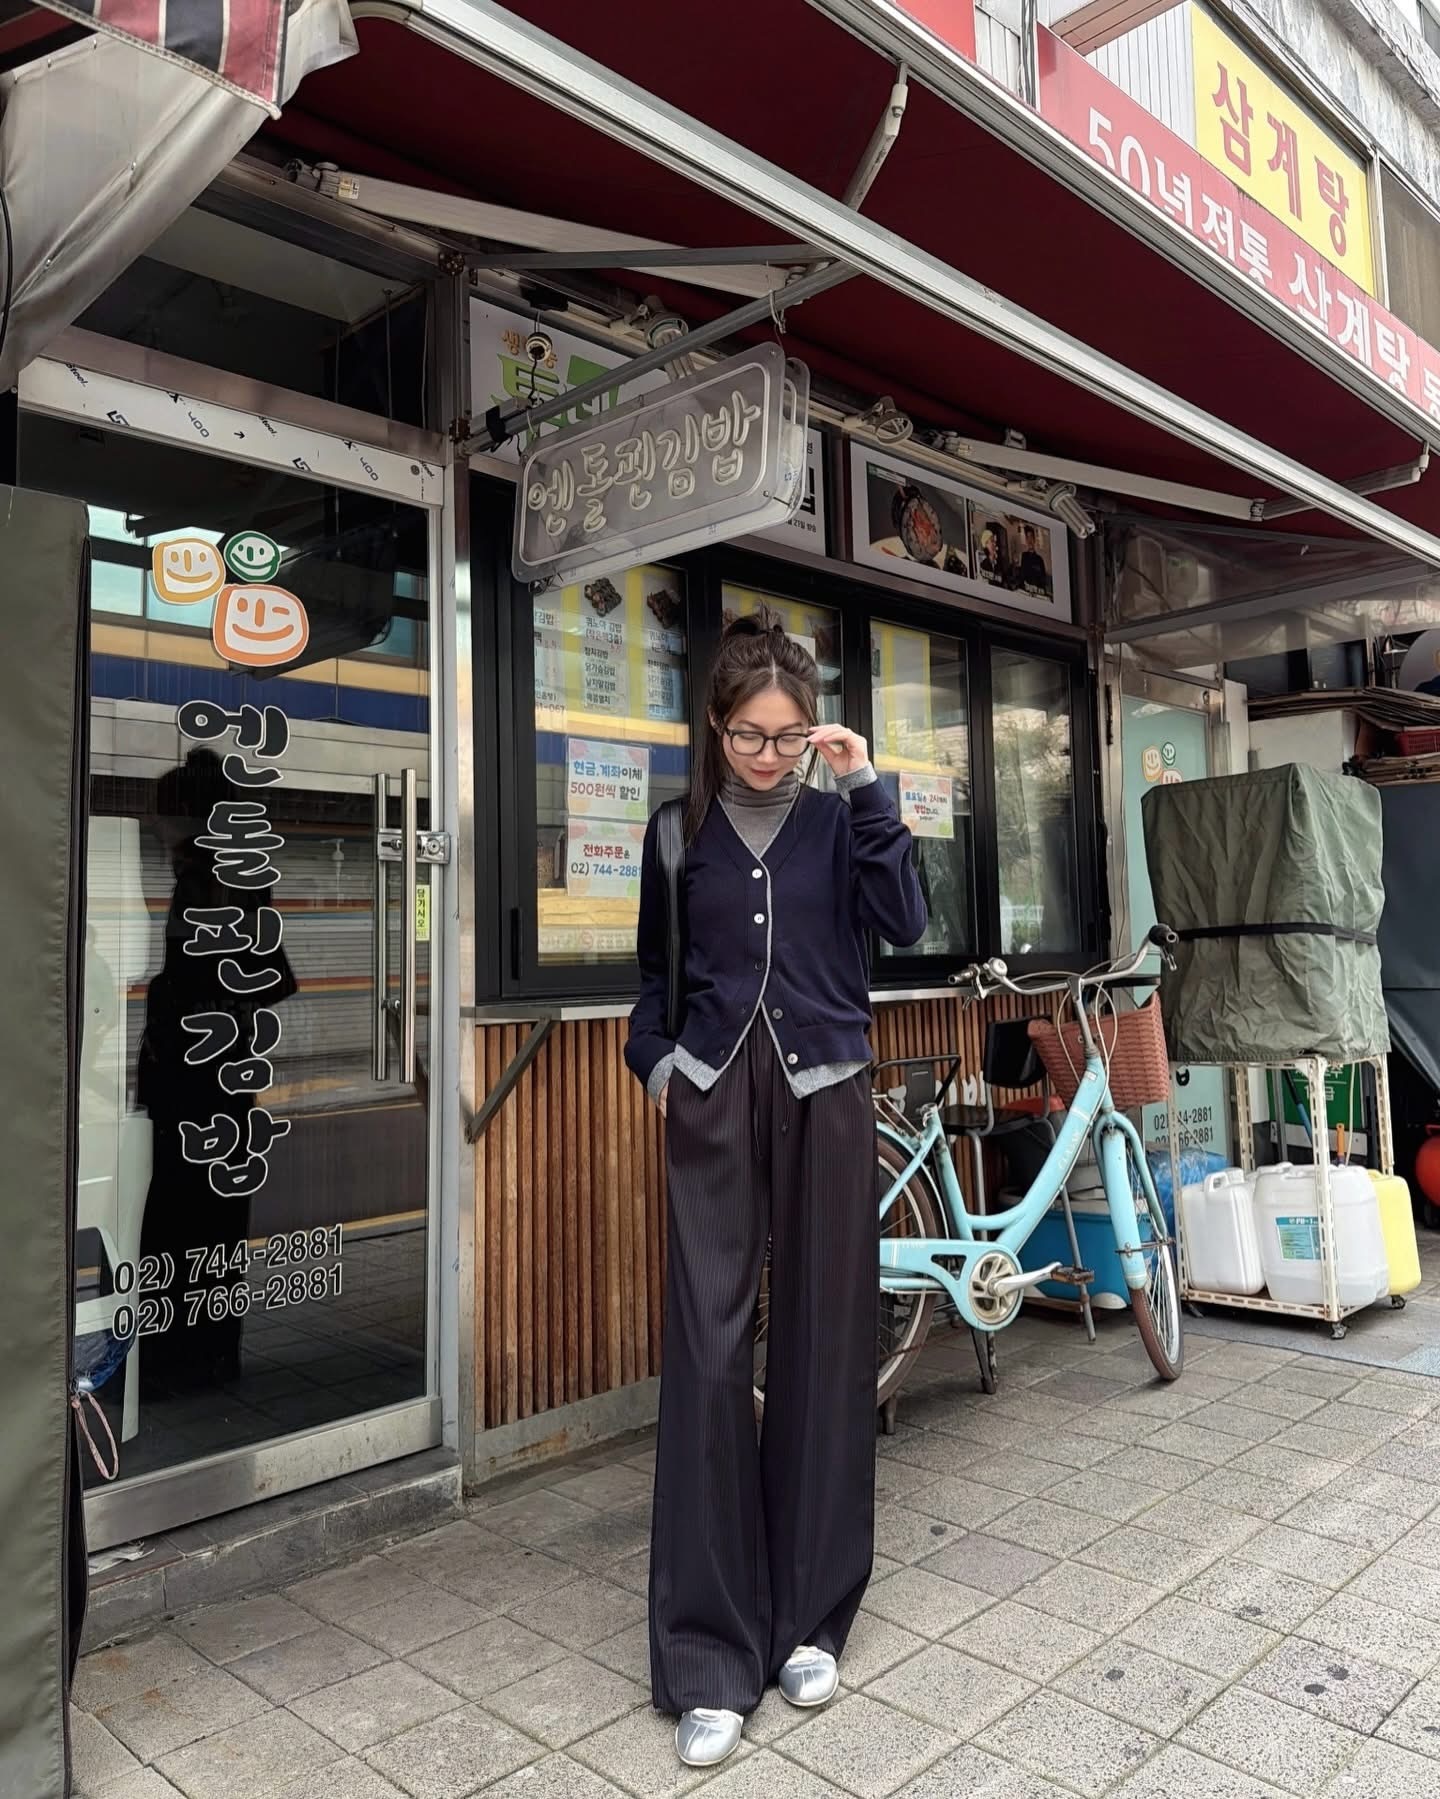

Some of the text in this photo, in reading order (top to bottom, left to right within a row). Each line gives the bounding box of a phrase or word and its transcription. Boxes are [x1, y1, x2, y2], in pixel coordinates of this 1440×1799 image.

[1212, 61, 1350, 257] 삼계탕
[527, 389, 761, 537] 엔돌핀김밥
[570, 781, 641, 801] 500원씩 할인
[571, 861, 589, 876] 02)
[583, 844, 630, 860] 전화주문은
[417, 888, 425, 928] 당기시오
[177, 699, 291, 1197] 엔돌핀김밥
[113, 1223, 343, 1296] 02) 744-2881
[112, 1262, 342, 1341] 02) 766-2881
